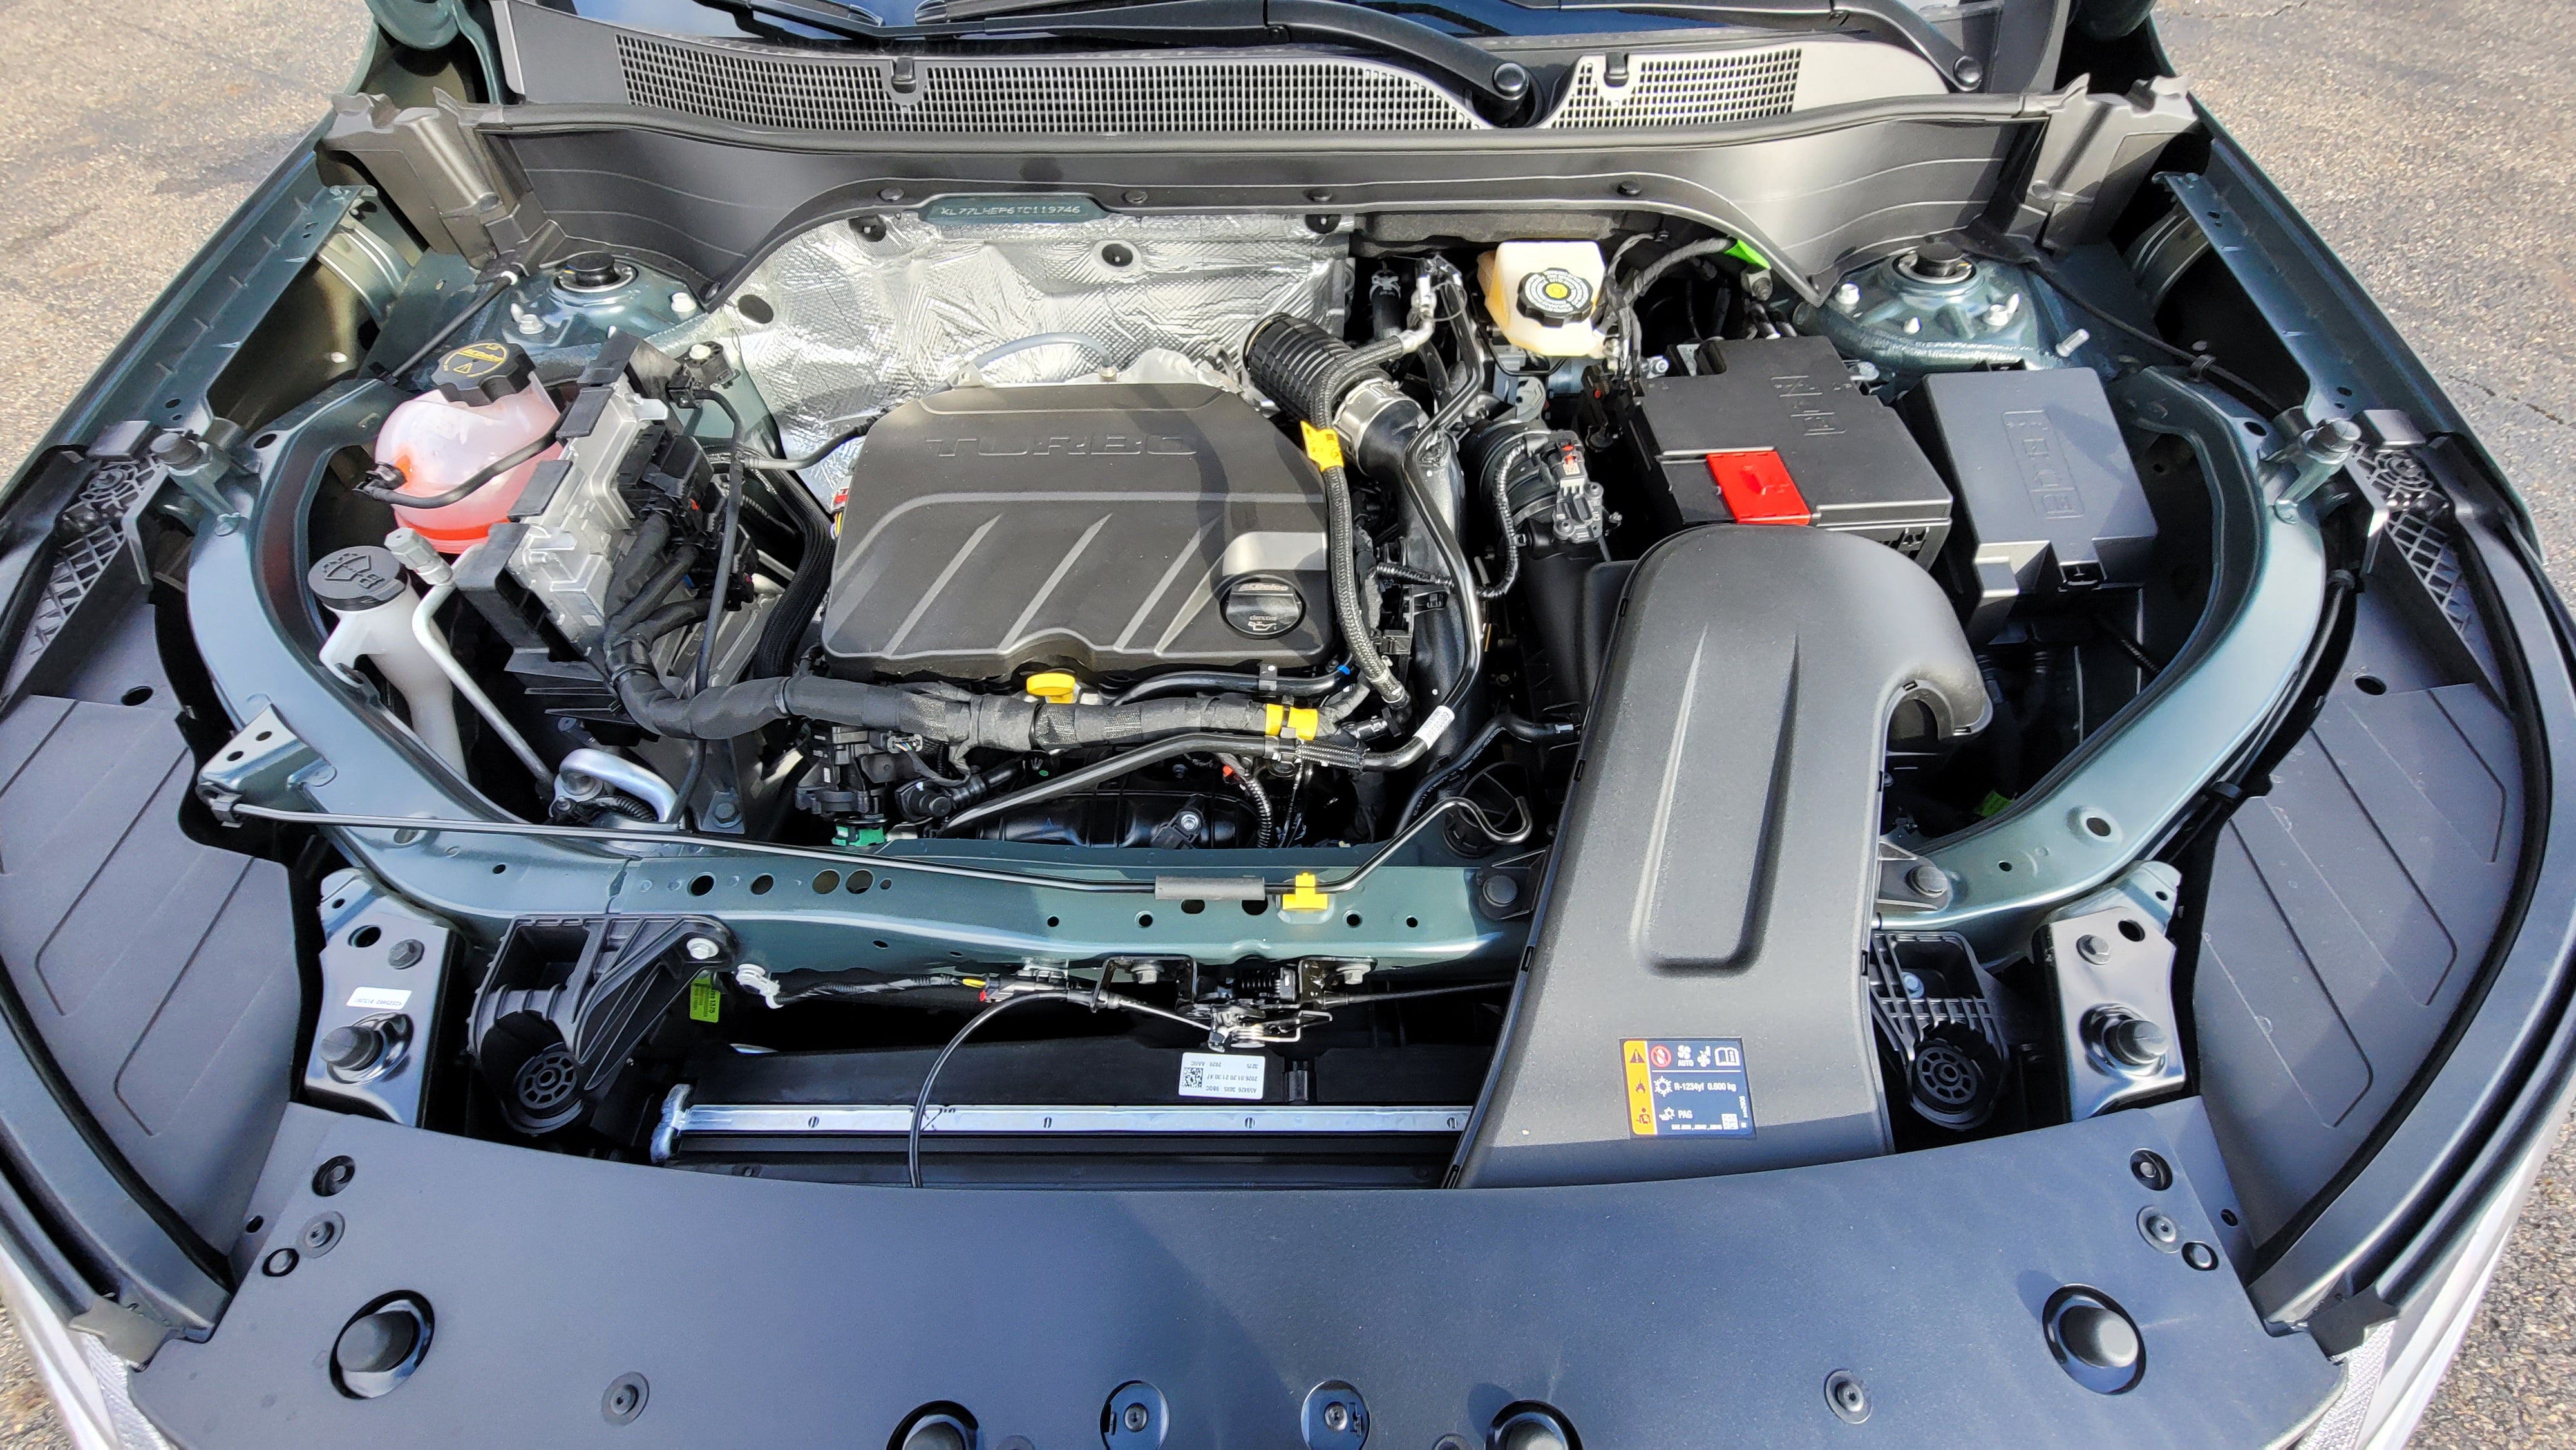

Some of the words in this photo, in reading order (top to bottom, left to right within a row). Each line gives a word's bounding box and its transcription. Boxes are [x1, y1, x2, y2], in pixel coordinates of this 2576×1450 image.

[940, 205, 1081, 216] KL77LHEP6TC119746
[925, 435, 1197, 457] TURBO
[1238, 582, 1289, 591] ACDelco
[1673, 1082, 1705, 1093] R-1234yf
[1707, 1082, 1726, 1091] 0.600
[1727, 1082, 1737, 1092] kg
[1678, 1109, 1693, 1119] PAG
